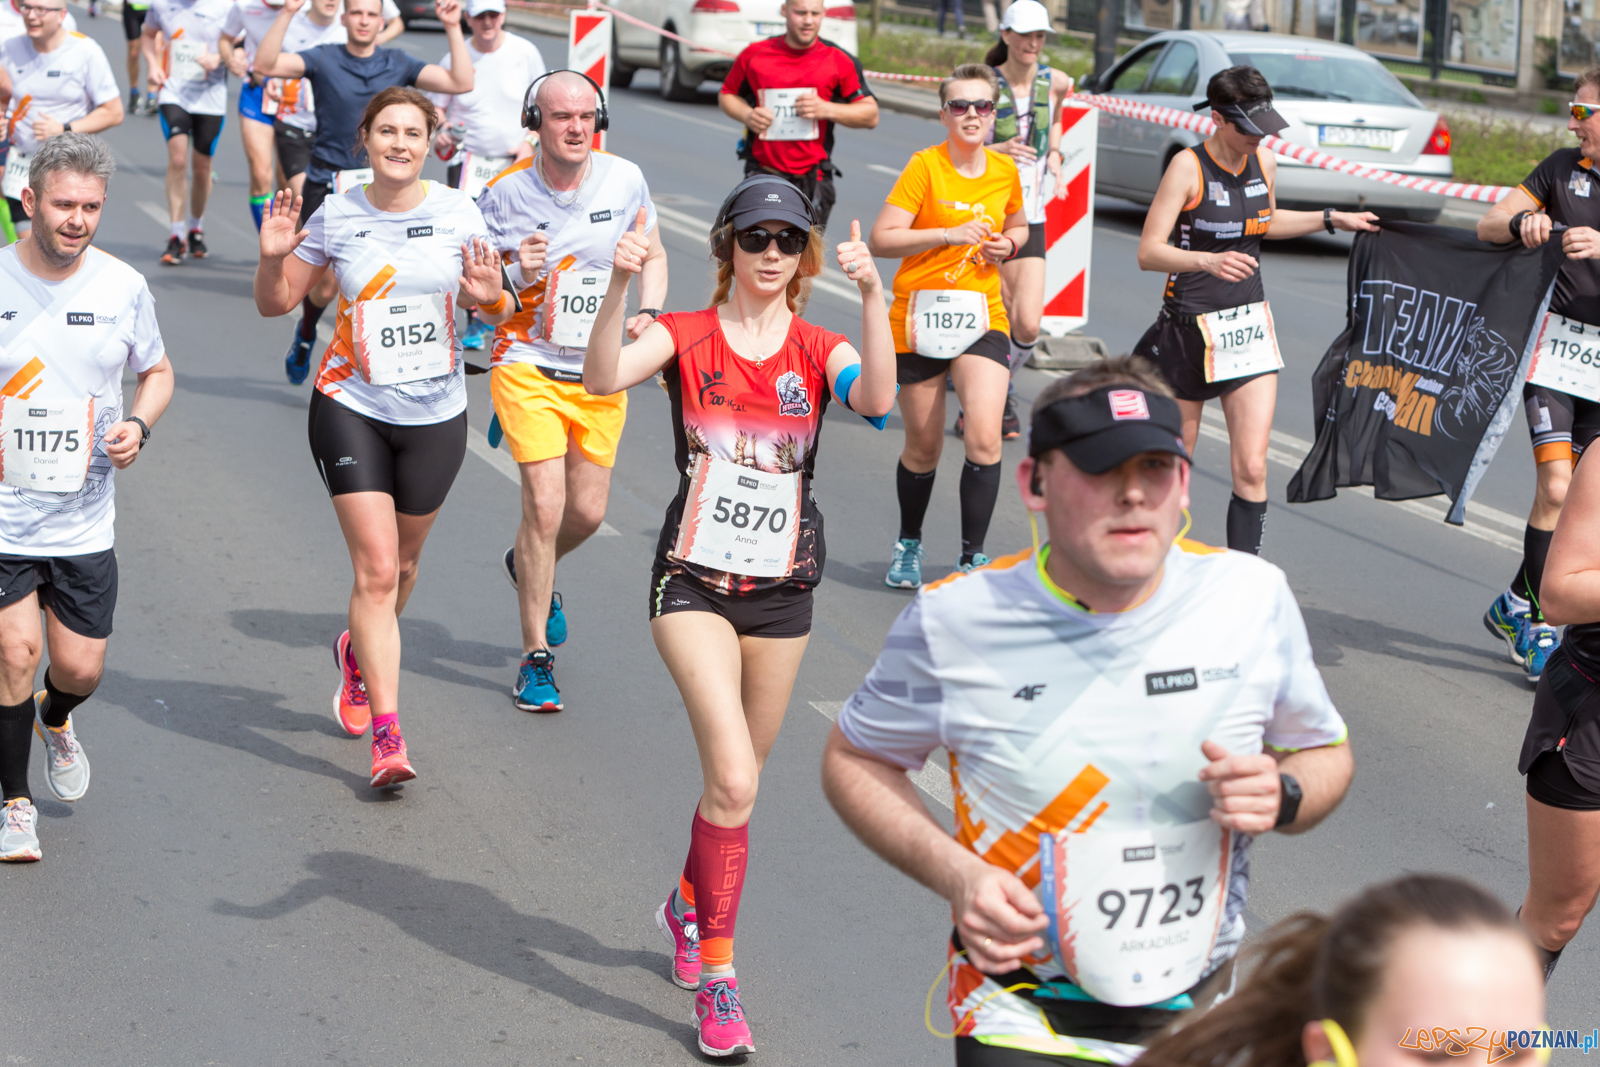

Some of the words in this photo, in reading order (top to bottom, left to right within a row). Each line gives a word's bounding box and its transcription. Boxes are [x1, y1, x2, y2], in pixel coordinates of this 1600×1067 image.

[923, 312, 976, 329] 11872
[1359, 279, 1477, 377] TEAM
[381, 321, 437, 348] 8152
[1220, 325, 1264, 349] 11874
[397, 350, 422, 358] Urszula
[13, 428, 79, 452] 11175
[712, 495, 787, 534] 5870
[734, 534, 758, 545] Anna
[1013, 684, 1047, 701] 4F
[1097, 875, 1205, 930] 9723
[1120, 930, 1190, 952] ARKADIUSZ
